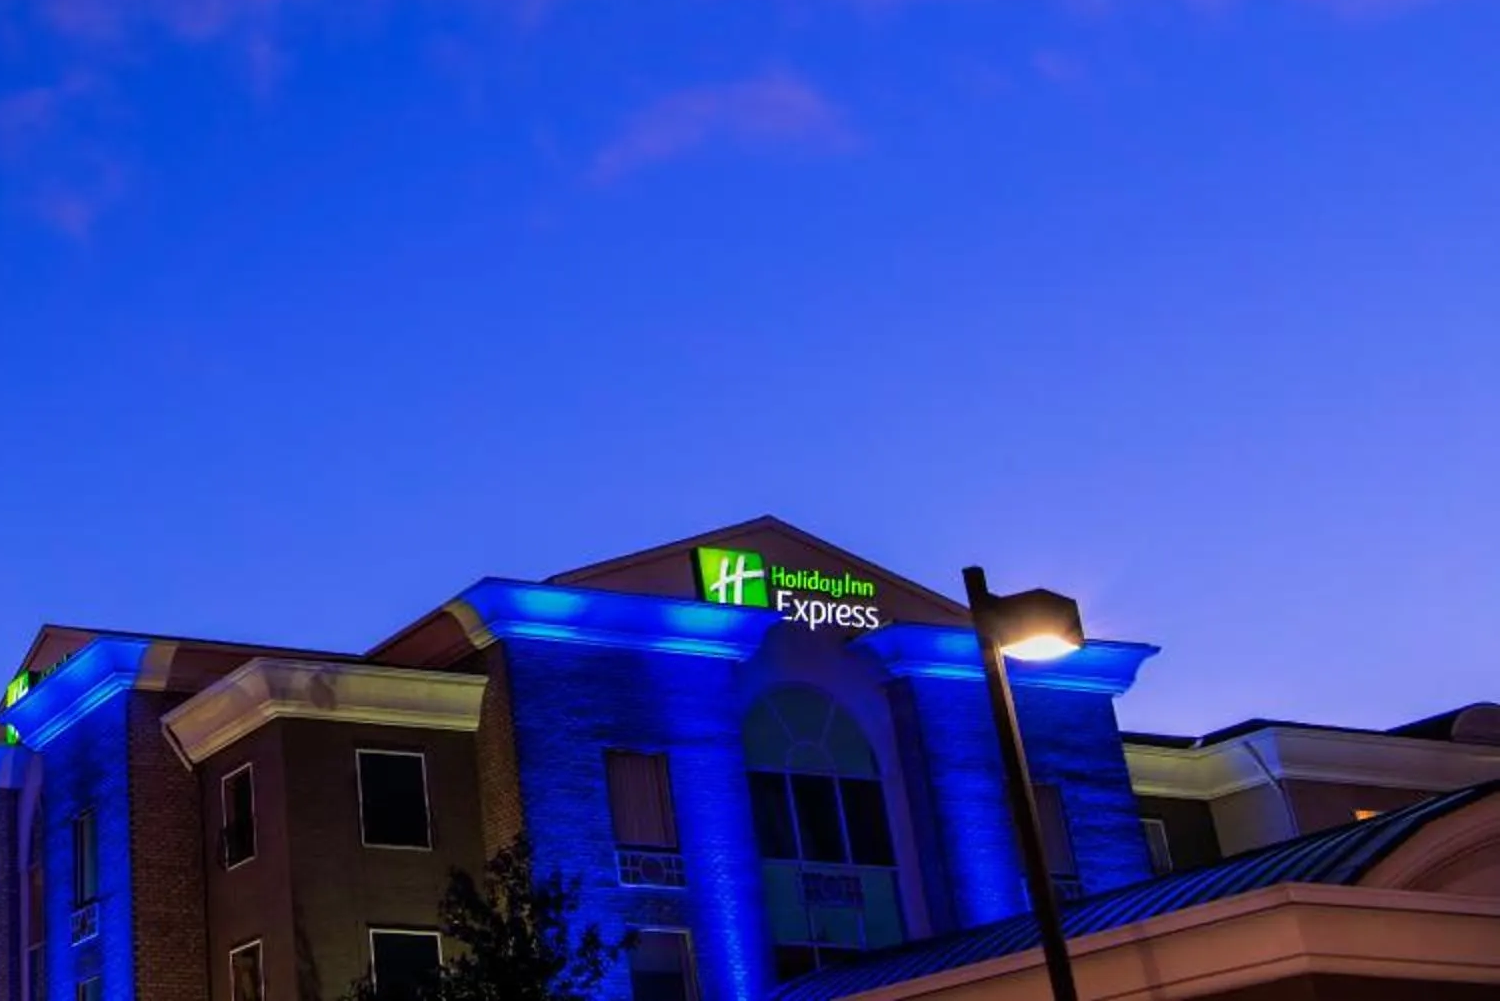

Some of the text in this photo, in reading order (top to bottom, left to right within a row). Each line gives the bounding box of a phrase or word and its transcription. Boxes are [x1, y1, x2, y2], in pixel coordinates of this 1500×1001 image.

[771, 566, 874, 596] Holiday Inn
[777, 591, 879, 630] Express
